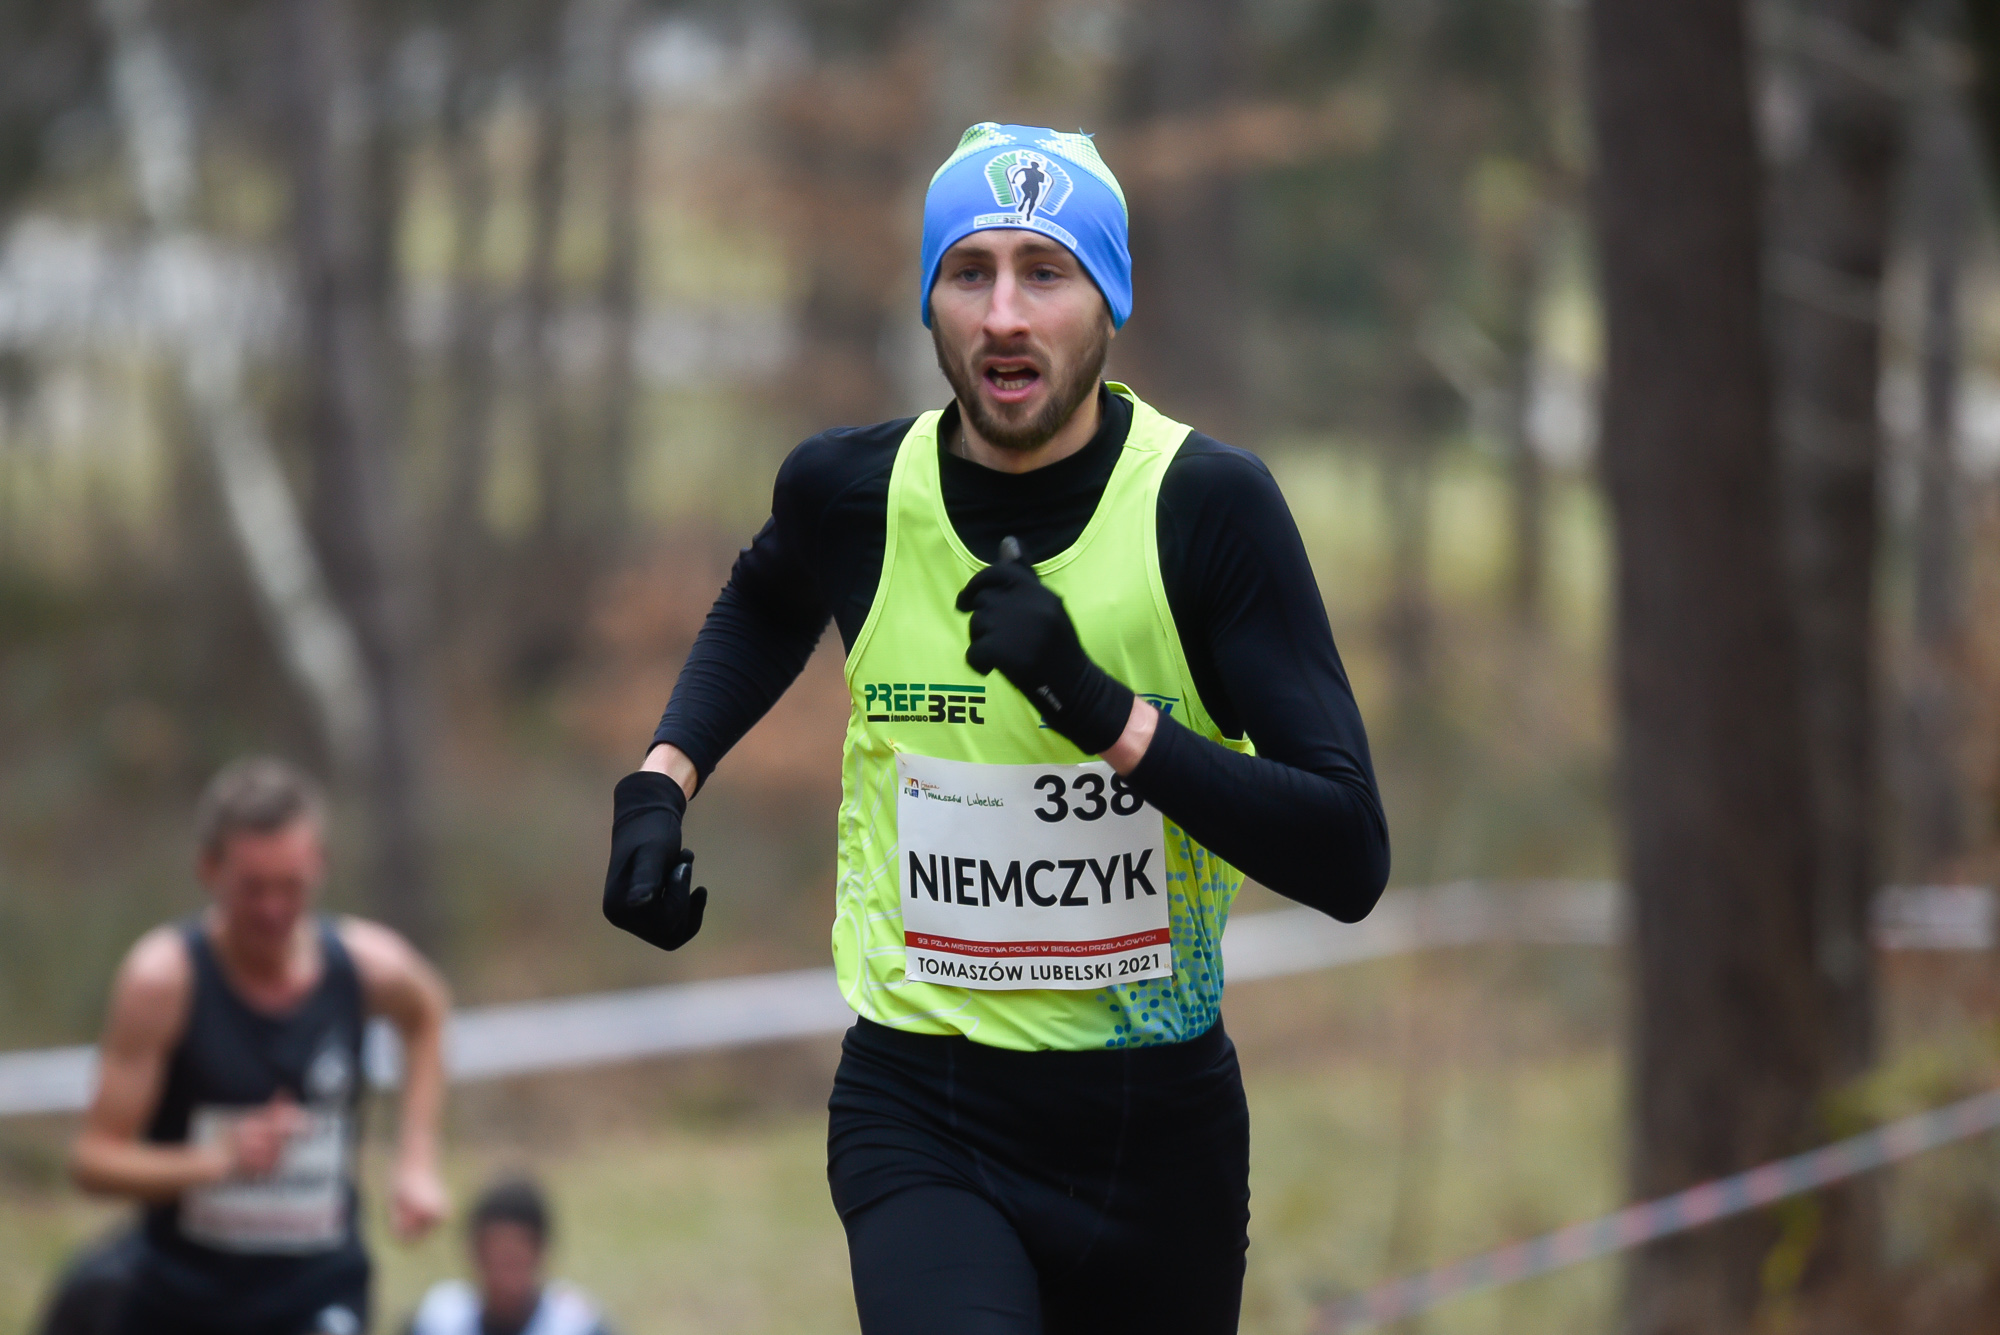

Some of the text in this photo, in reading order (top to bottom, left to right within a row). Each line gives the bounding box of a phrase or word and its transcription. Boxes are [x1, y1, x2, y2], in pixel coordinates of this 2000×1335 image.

[966, 792, 1004, 807] Lubelski
[1033, 772, 1145, 823] 338
[908, 848, 1158, 908] NIEMCZYK
[917, 937, 930, 946] 93.
[950, 942, 1008, 954] MISTRZOSTWA
[1008, 945, 1039, 954] POLSKI
[1041, 945, 1050, 953] W
[1050, 944, 1088, 953] BIEGACH
[917, 953, 1159, 982] TOMASZÓW LUBELSKI 2021
